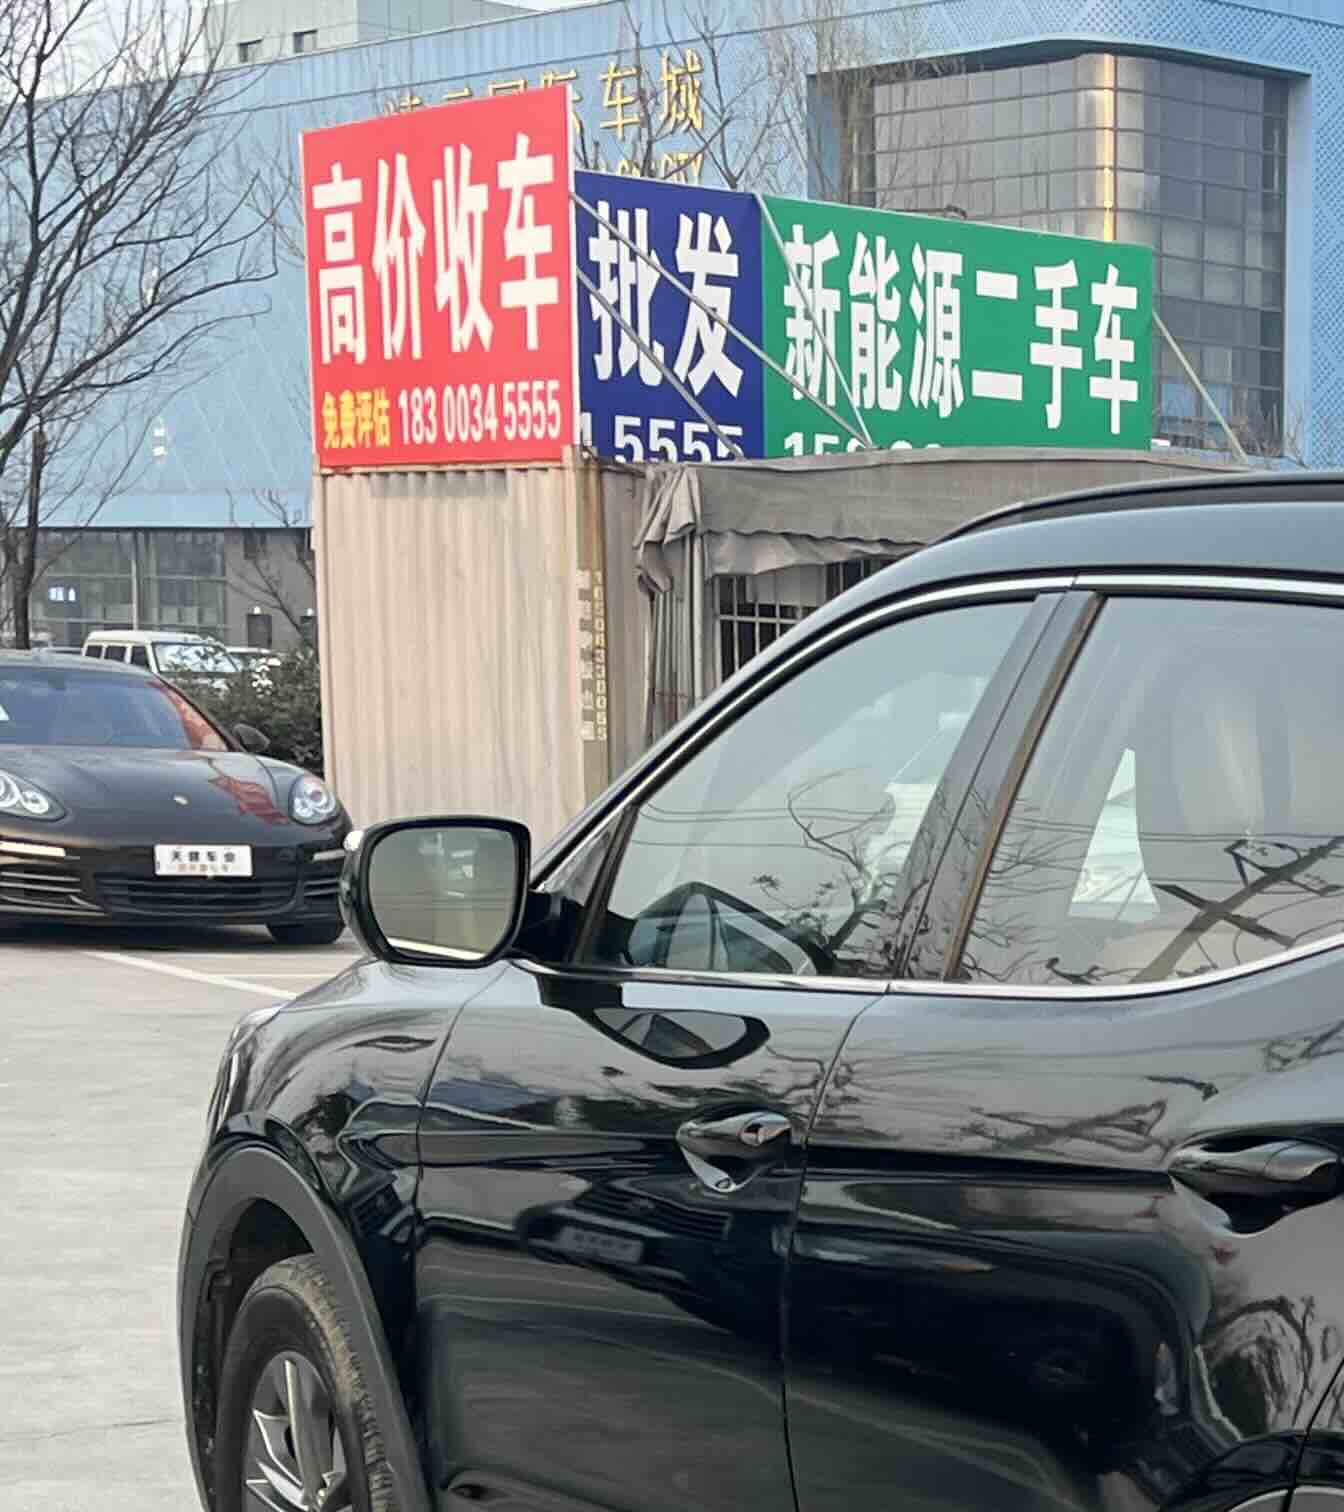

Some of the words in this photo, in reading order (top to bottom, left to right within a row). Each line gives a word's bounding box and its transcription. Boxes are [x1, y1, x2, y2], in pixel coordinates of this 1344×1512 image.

[312, 134, 560, 363] 高价收车
[588, 201, 743, 398] 批发
[784, 224, 1138, 434] 新能源二手车
[399, 386, 437, 445] 183
[443, 383, 498, 443] 0034
[503, 380, 561, 440] 5555
